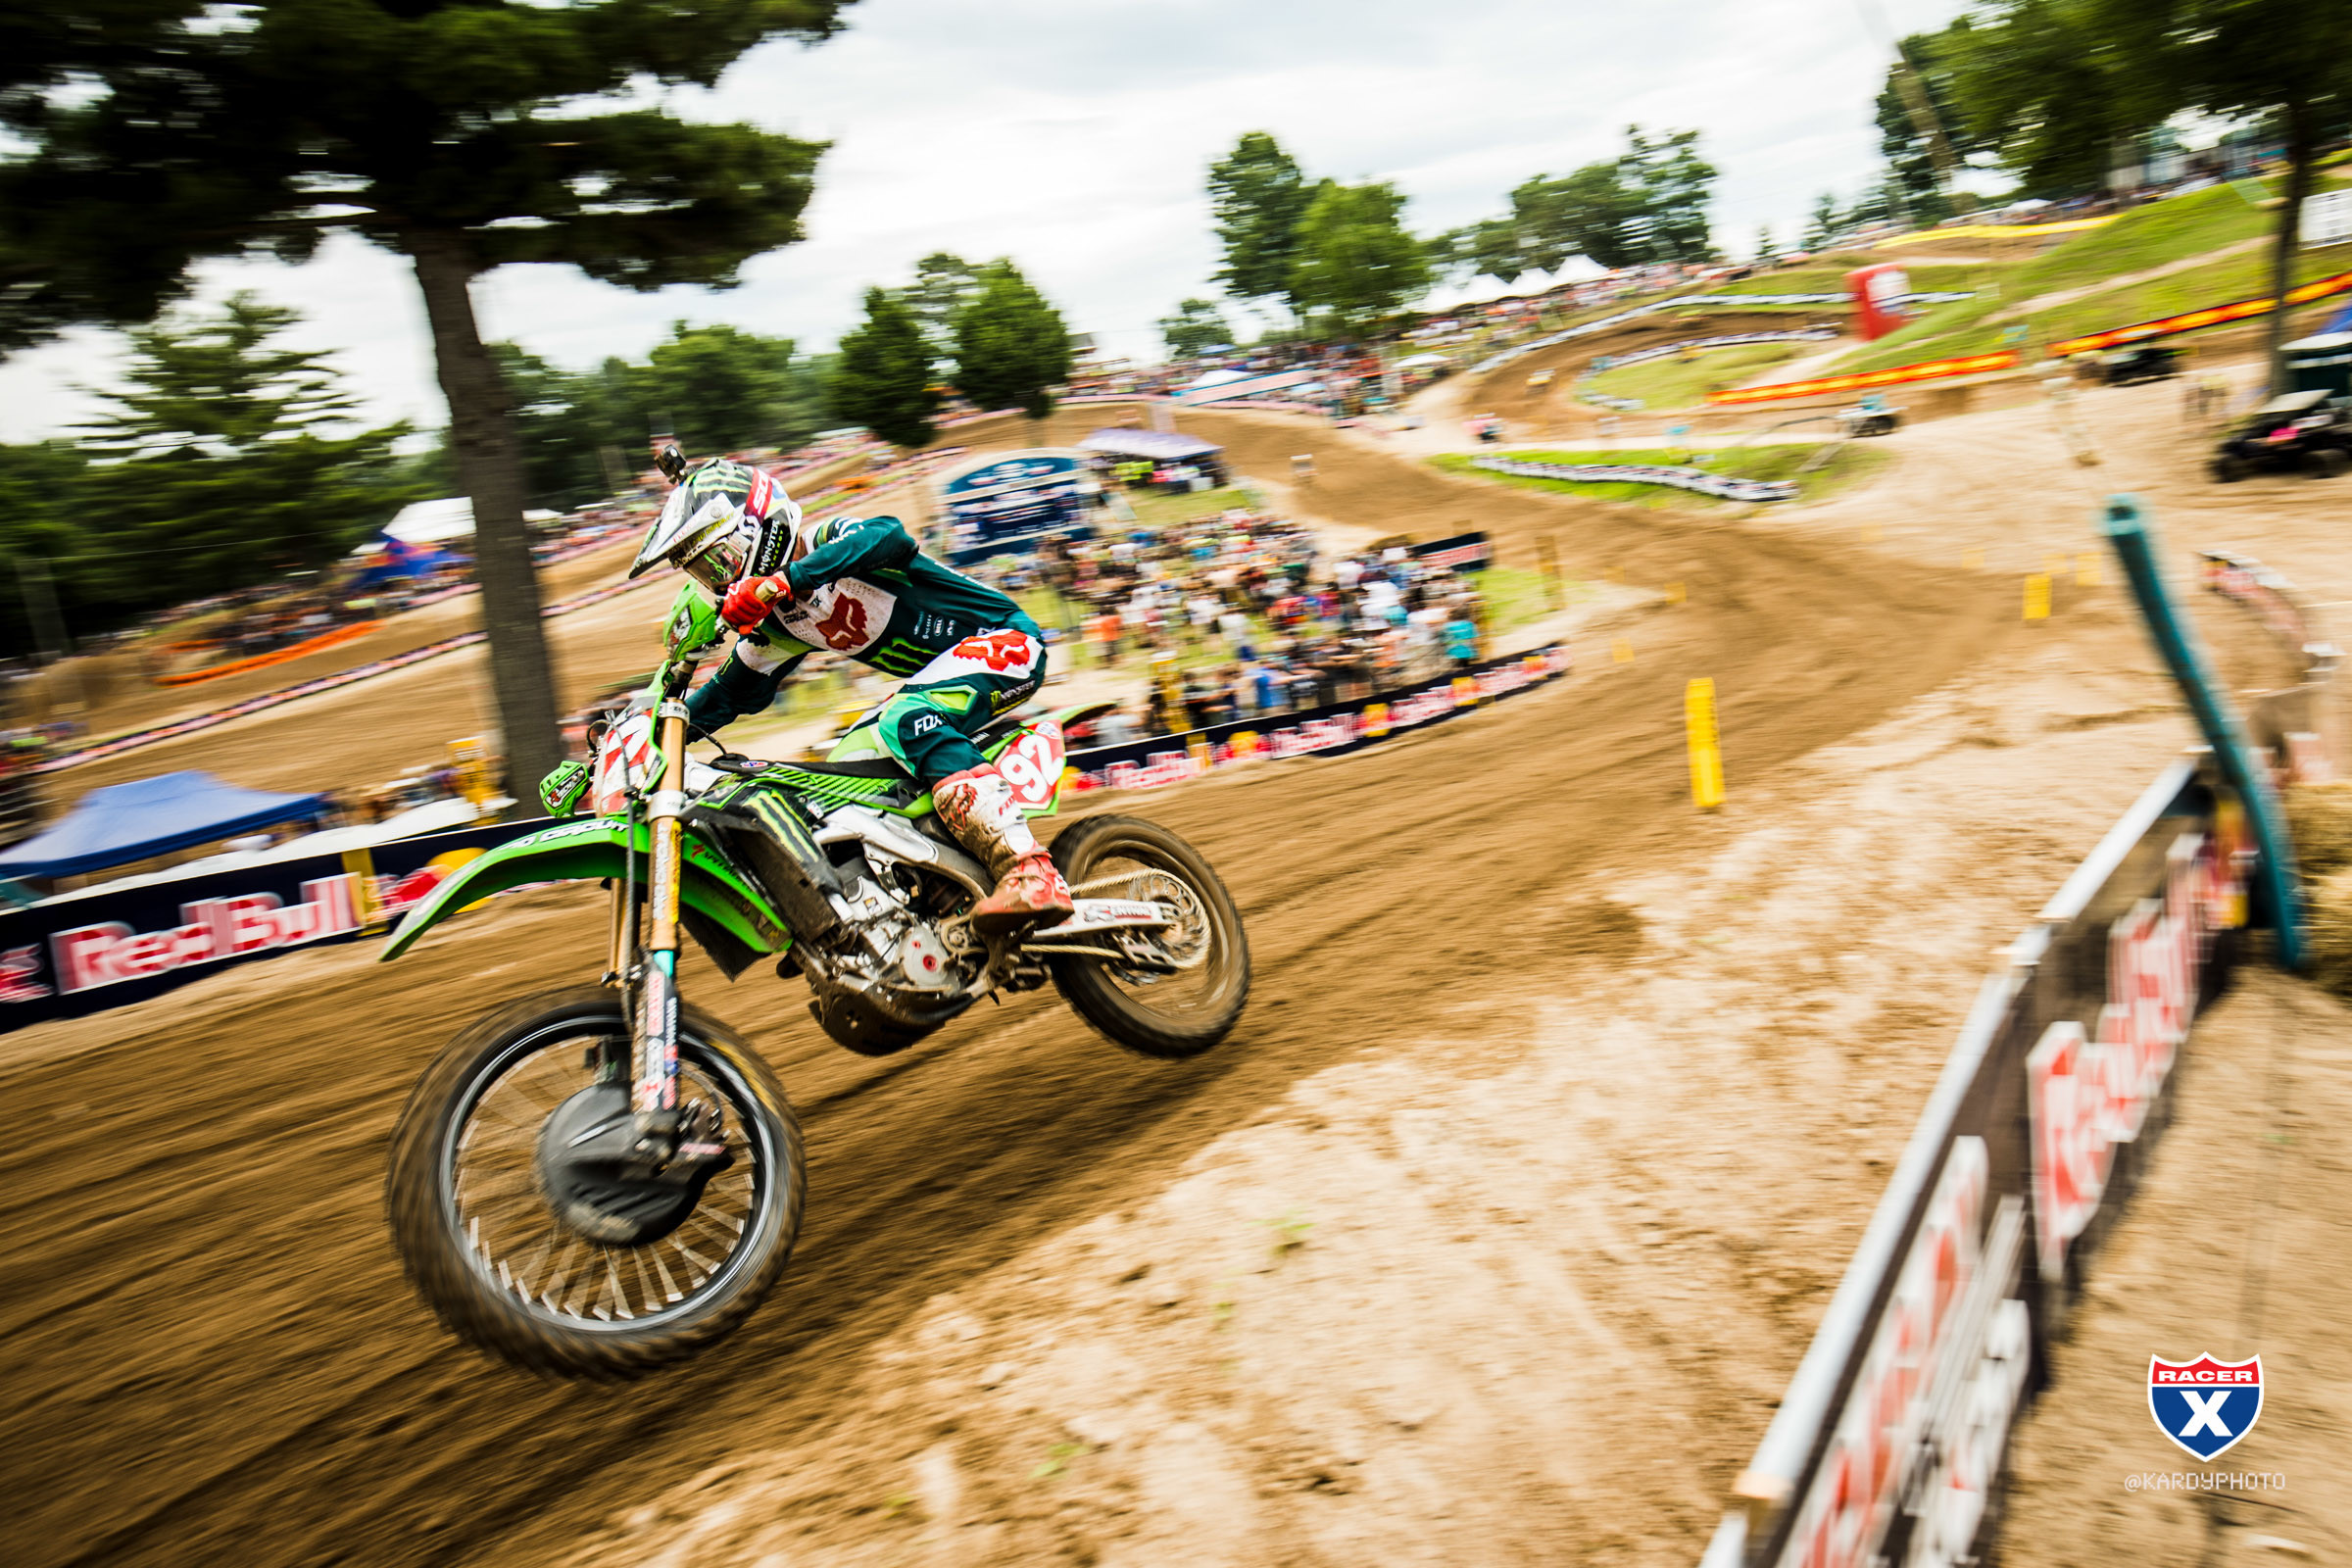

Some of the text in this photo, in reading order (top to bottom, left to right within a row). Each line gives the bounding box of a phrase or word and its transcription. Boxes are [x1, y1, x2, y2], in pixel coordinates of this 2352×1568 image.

[759, 519, 780, 573] MONSTER
[914, 714, 943, 737] FOX
[1000, 734, 1064, 803] 92
